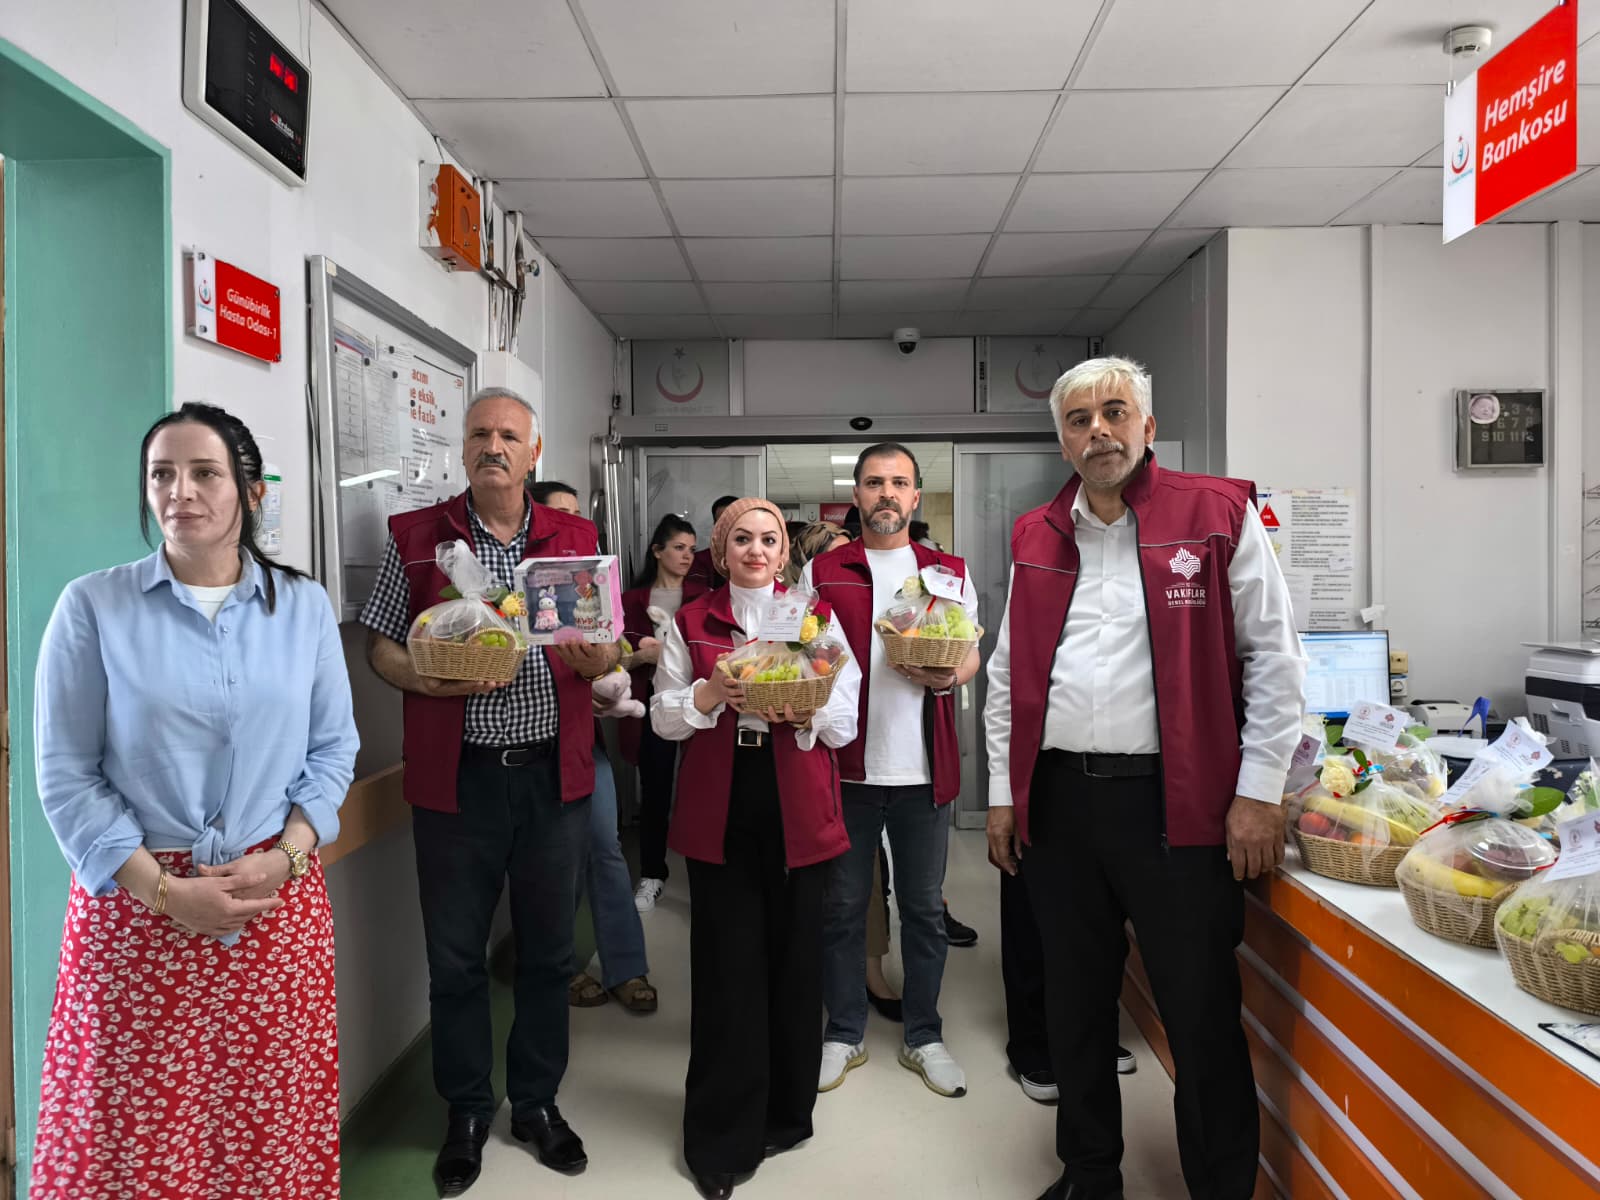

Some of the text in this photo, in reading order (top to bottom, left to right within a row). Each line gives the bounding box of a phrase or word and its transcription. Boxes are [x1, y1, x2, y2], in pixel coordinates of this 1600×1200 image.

[1484, 59, 1566, 132] Hemşire
[1481, 99, 1568, 173] Bankosu
[226, 288, 271, 319] Günübirlik
[219, 303, 246, 327] Hasta
[246, 316, 277, 340] Odası-1
[418, 405, 435, 424] fazla
[1512, 403, 1520, 415] 3
[1497, 417, 1505, 429] 6
[1512, 417, 1520, 429] 7
[1481, 431, 1490, 442] 9
[1492, 431, 1505, 442] 10
[1510, 431, 1519, 443] 11
[1166, 589, 1206, 599] VAKIFLAR
